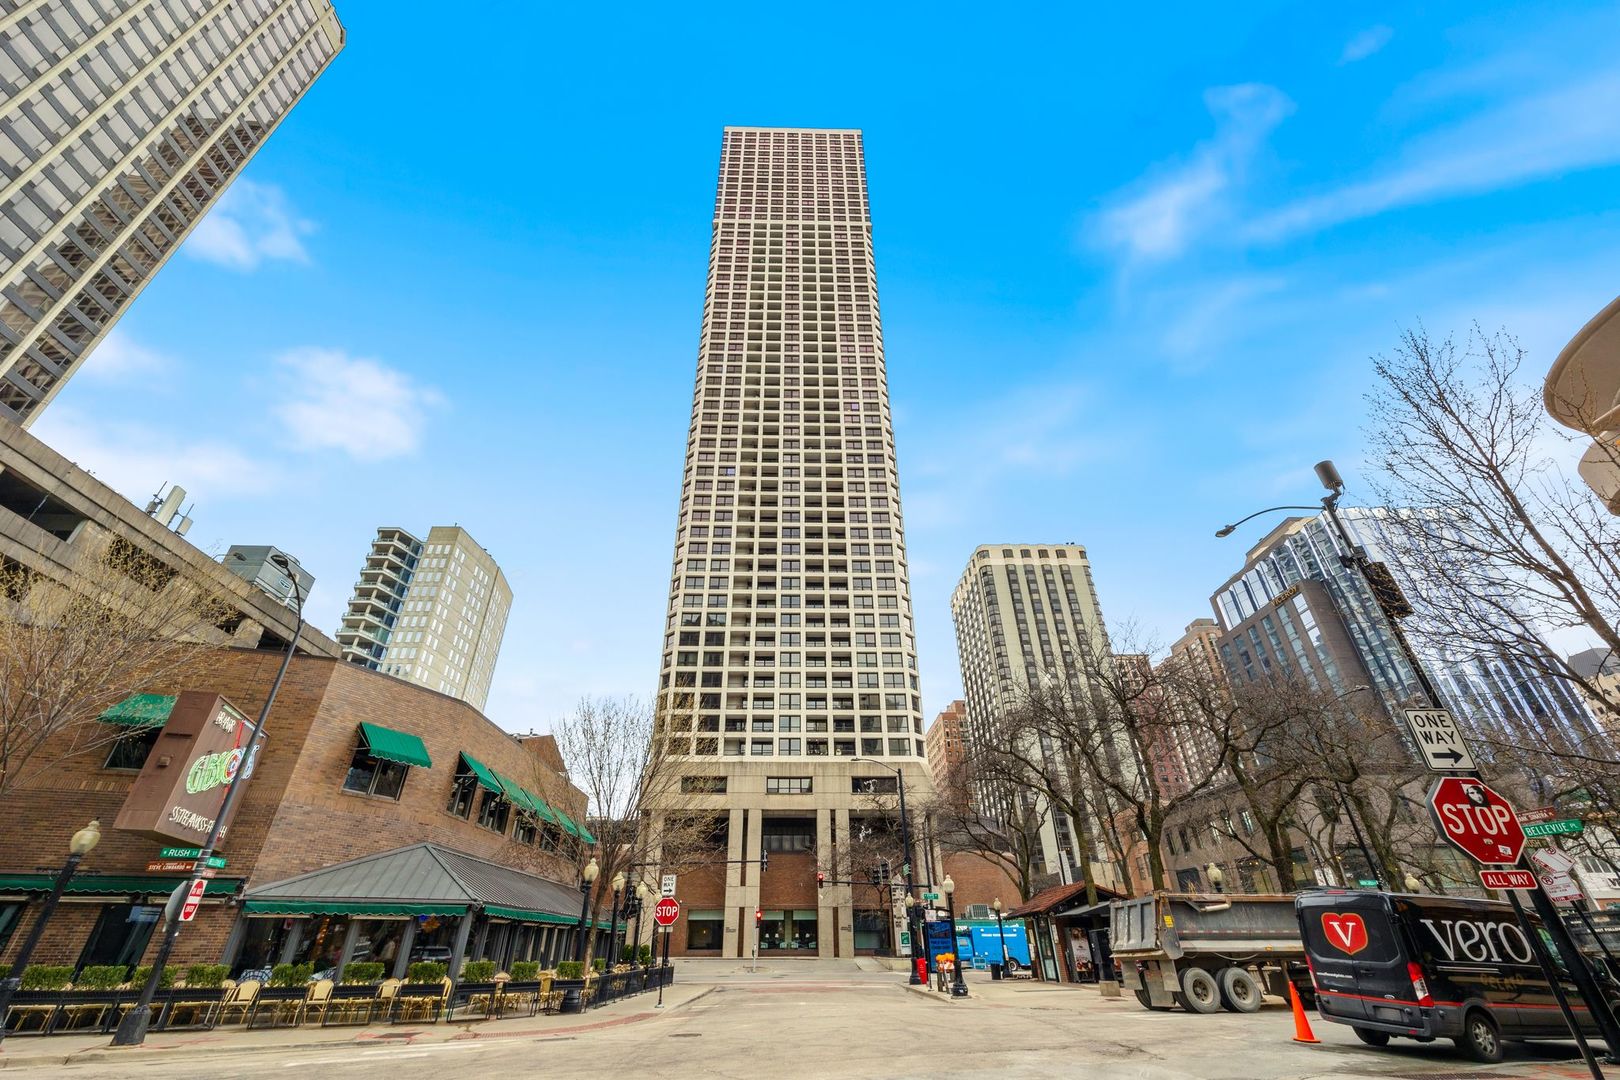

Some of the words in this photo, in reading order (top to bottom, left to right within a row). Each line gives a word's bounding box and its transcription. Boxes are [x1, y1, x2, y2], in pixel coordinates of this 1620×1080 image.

[1271, 586, 1297, 605] VICEROY
[1414, 714, 1451, 728] ONE
[1418, 731, 1456, 745] WAY
[1442, 803, 1511, 836] STOP
[1525, 822, 1569, 837] BELLEVUE
[167, 848, 191, 857] RUSH
[1488, 874, 1508, 887] ALL
[1508, 873, 1530, 886] WAY
[656, 906, 678, 917] STOP
[1329, 921, 1356, 947] V
[1420, 919, 1532, 963] vero
